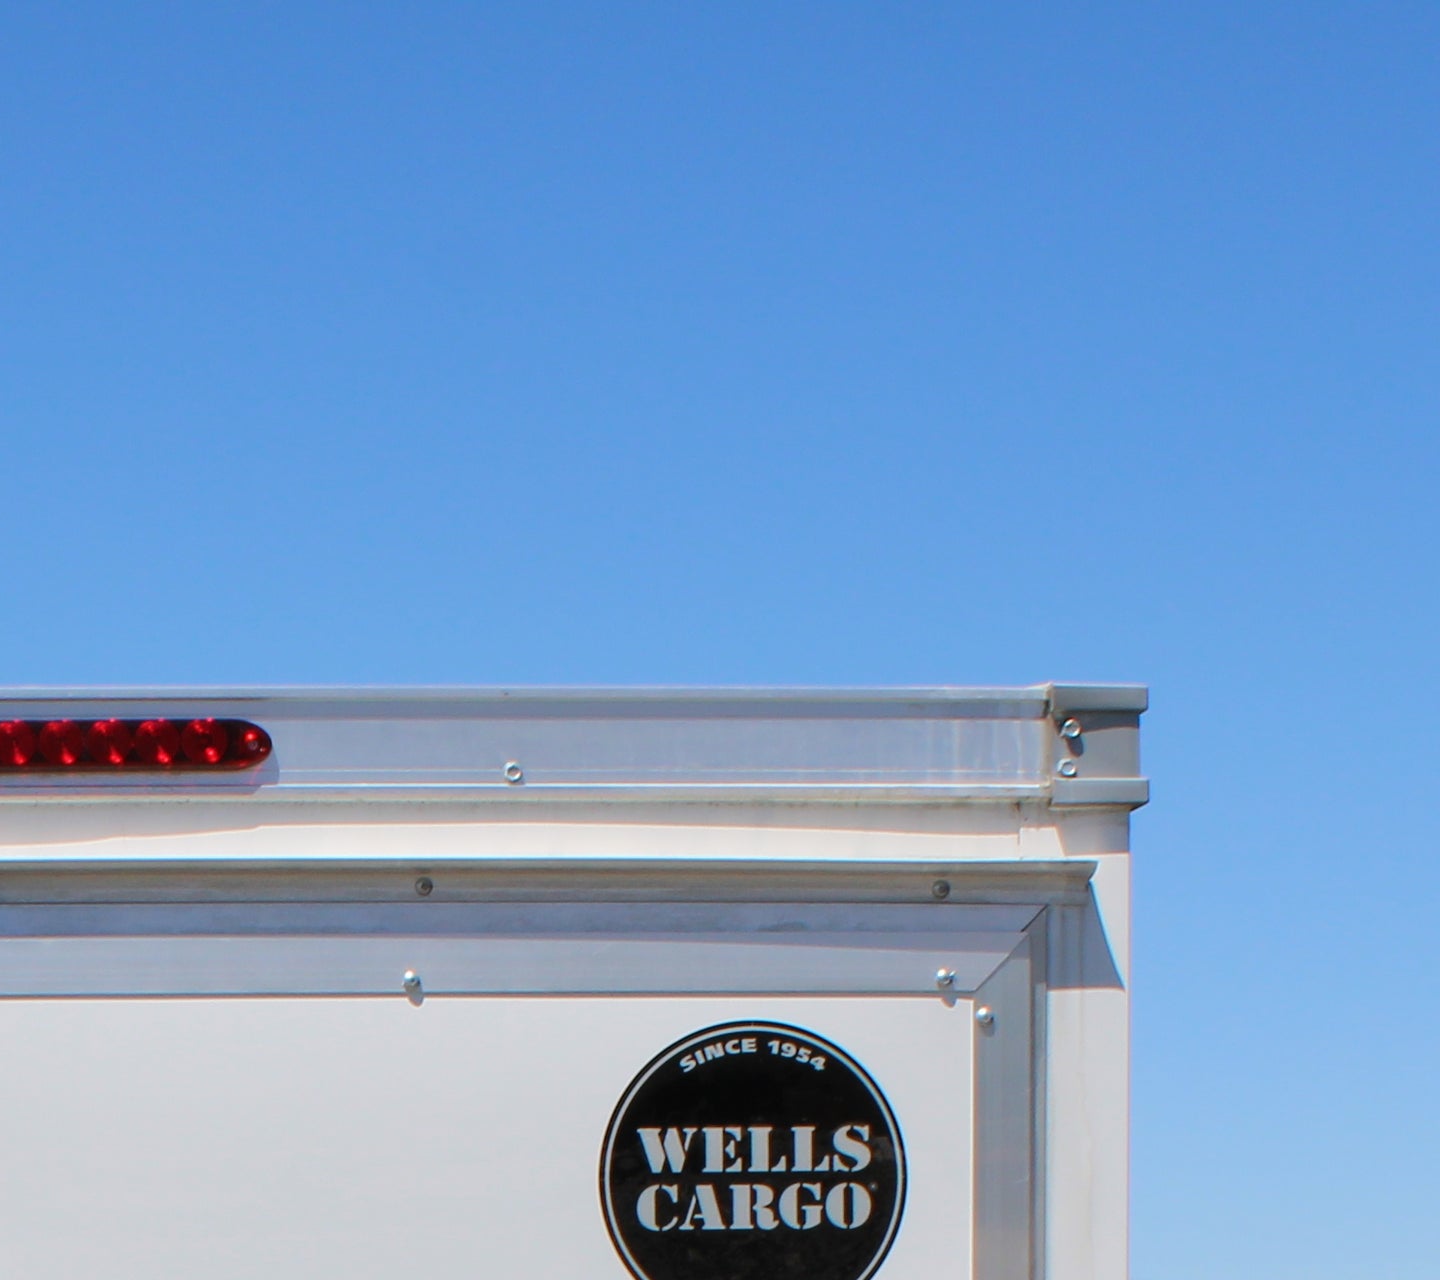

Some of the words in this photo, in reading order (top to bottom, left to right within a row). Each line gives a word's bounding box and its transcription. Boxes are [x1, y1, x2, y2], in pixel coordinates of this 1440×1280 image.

[678, 1037, 758, 1073] SINCE
[767, 1039, 826, 1071] 1954
[636, 1124, 872, 1174] WELLS
[636, 1182, 872, 1232] CARGO
